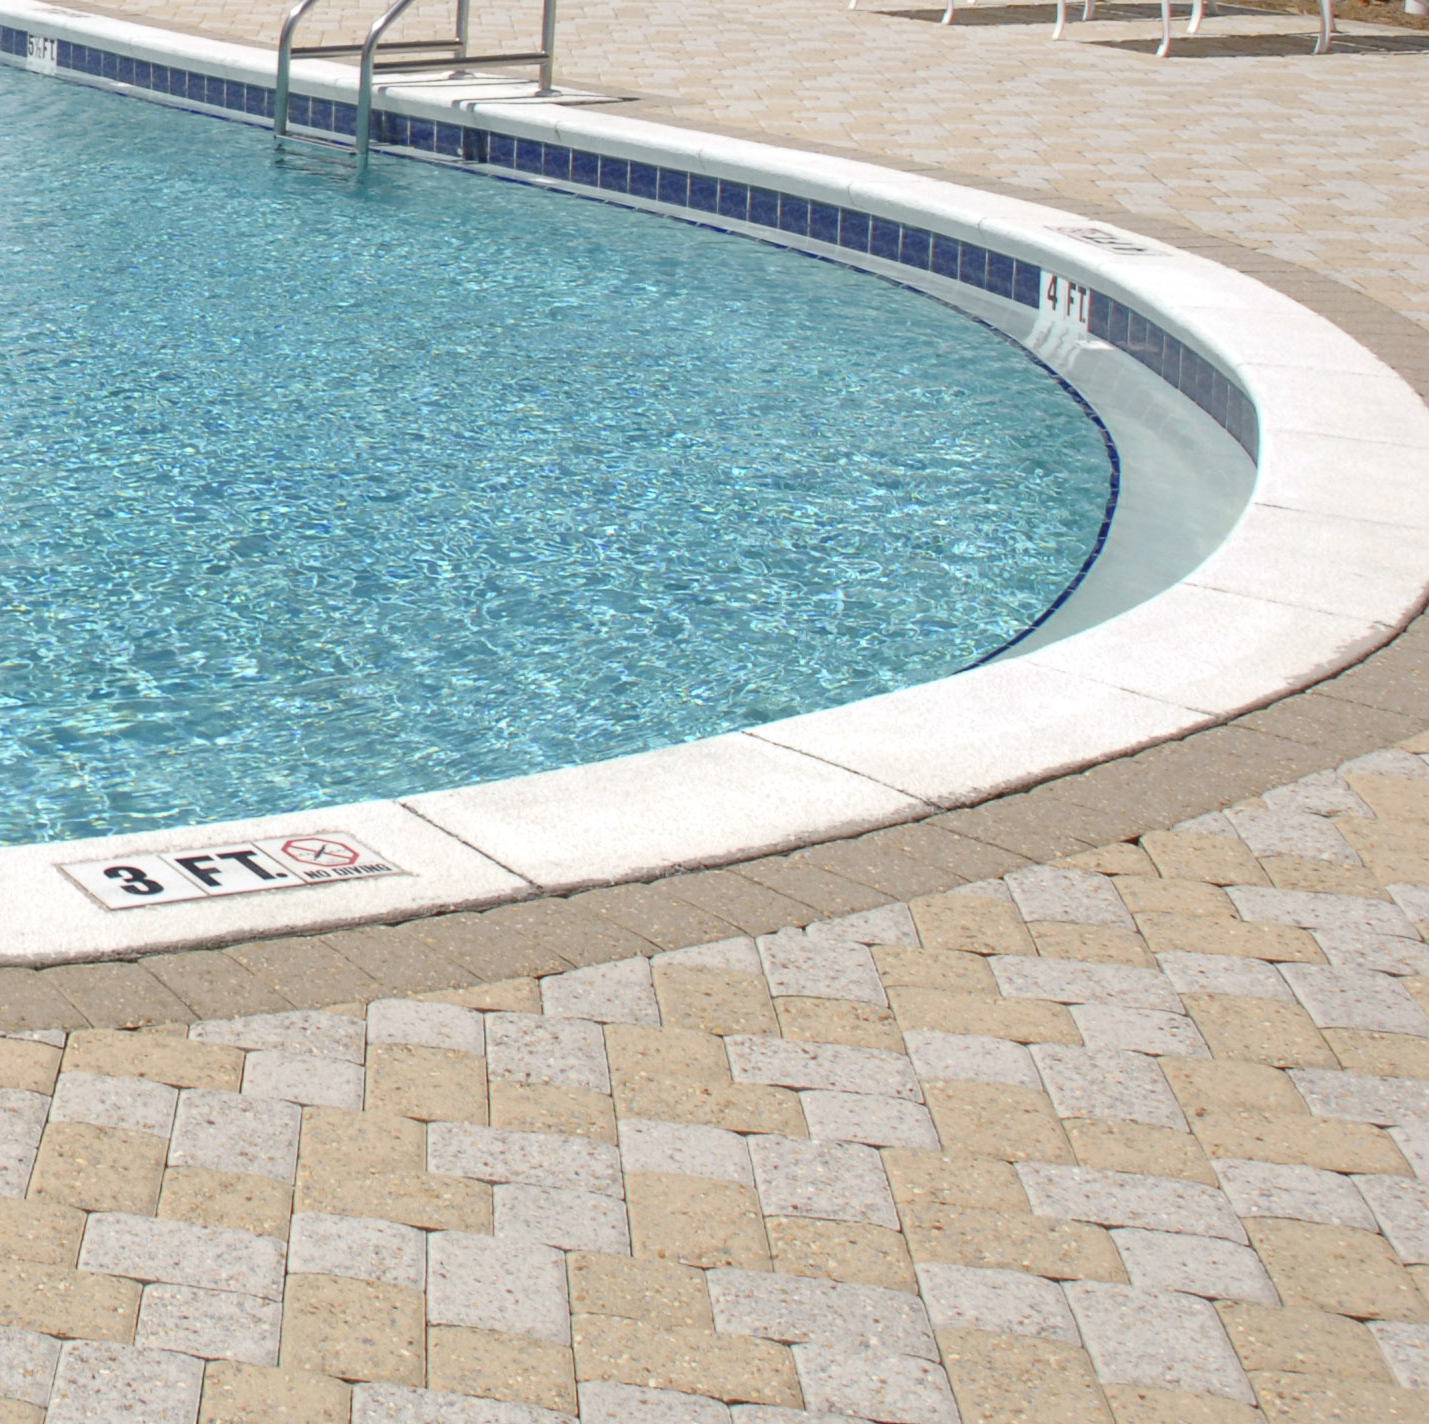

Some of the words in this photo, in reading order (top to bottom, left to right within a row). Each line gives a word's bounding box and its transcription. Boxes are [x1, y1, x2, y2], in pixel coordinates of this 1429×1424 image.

[1047, 274, 1058, 311] 4
[102, 865, 165, 896] 3
[174, 850, 290, 888] FT.
[303, 869, 332, 879] NO
[331, 863, 393, 876] DIVING
